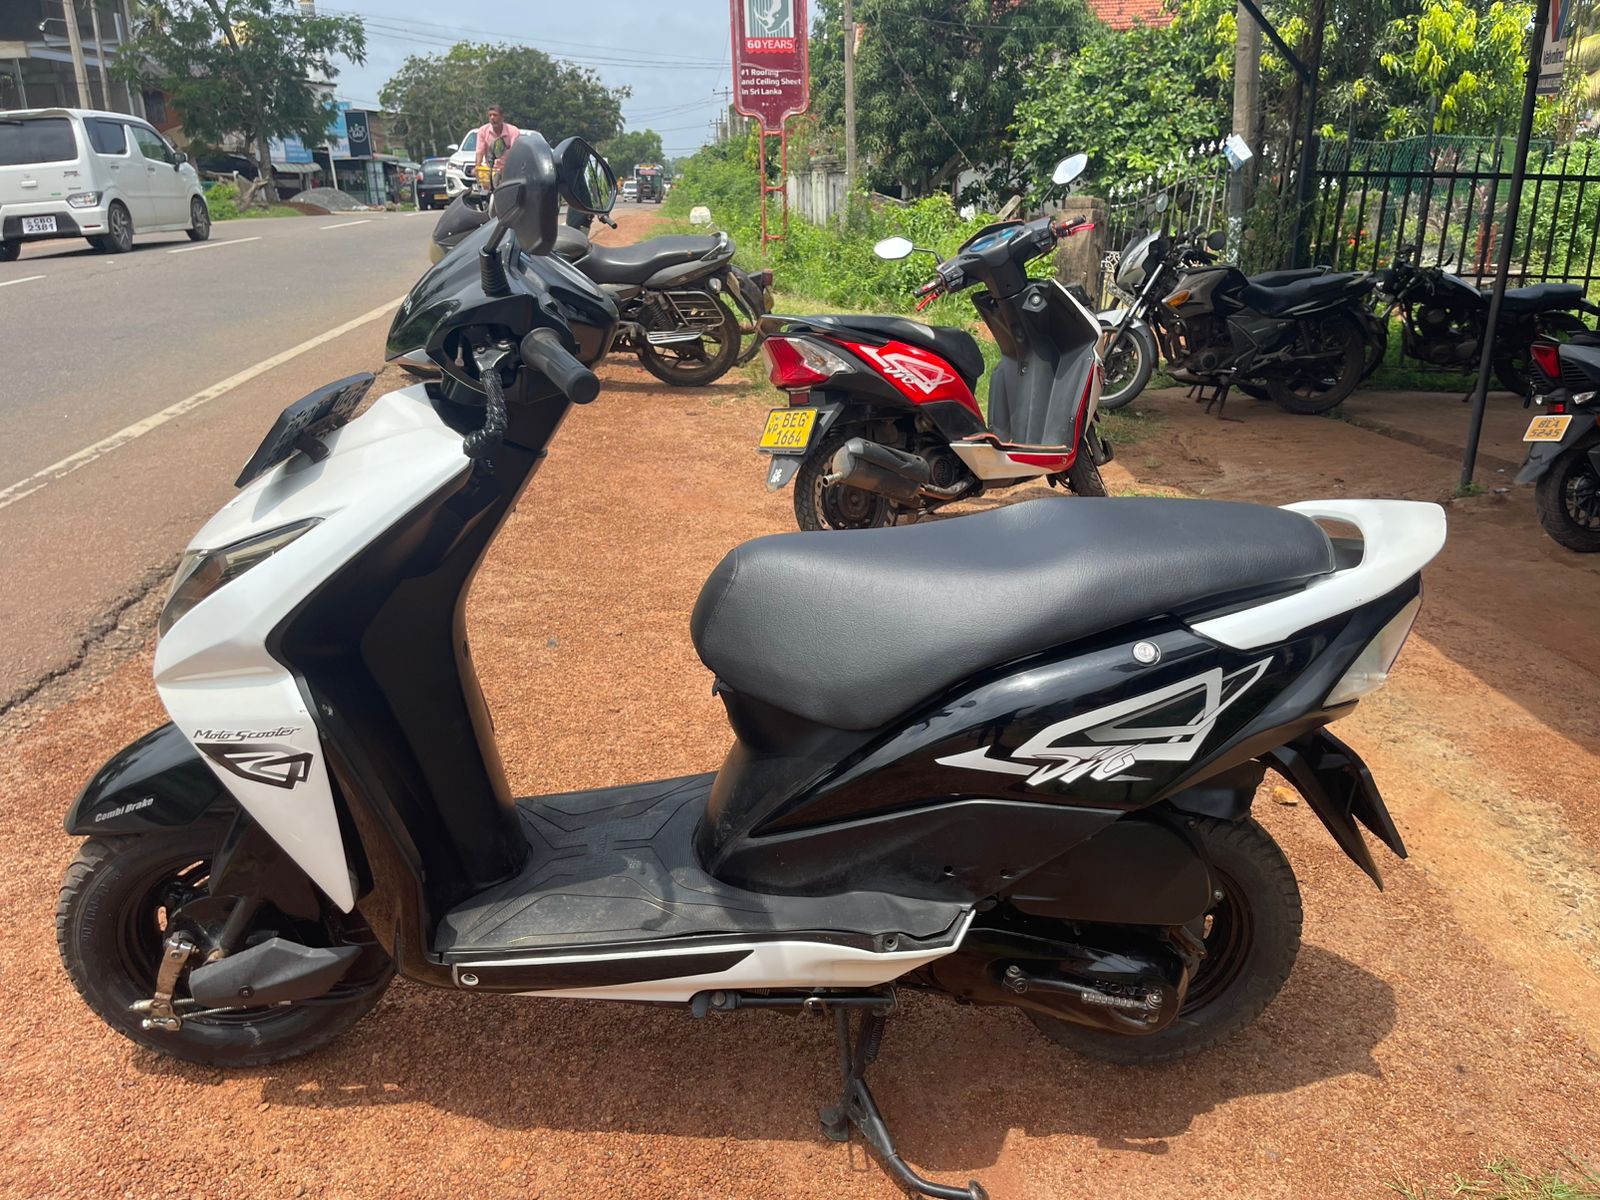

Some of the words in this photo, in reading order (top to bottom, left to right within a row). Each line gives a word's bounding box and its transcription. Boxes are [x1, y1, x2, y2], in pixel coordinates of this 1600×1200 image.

[747, 40, 761, 49] 60
[762, 40, 793, 49] YEARS
[751, 69, 779, 77] Roofing
[756, 78, 780, 87] Ceiling
[27, 223, 55, 232] 2381
[782, 412, 808, 428] BEG
[774, 430, 803, 446] 1664
[193, 729, 233, 740] Moto
[235, 727, 302, 741] Scooter
[95, 805, 125, 823] Combi
[125, 798, 154, 814] Brake
